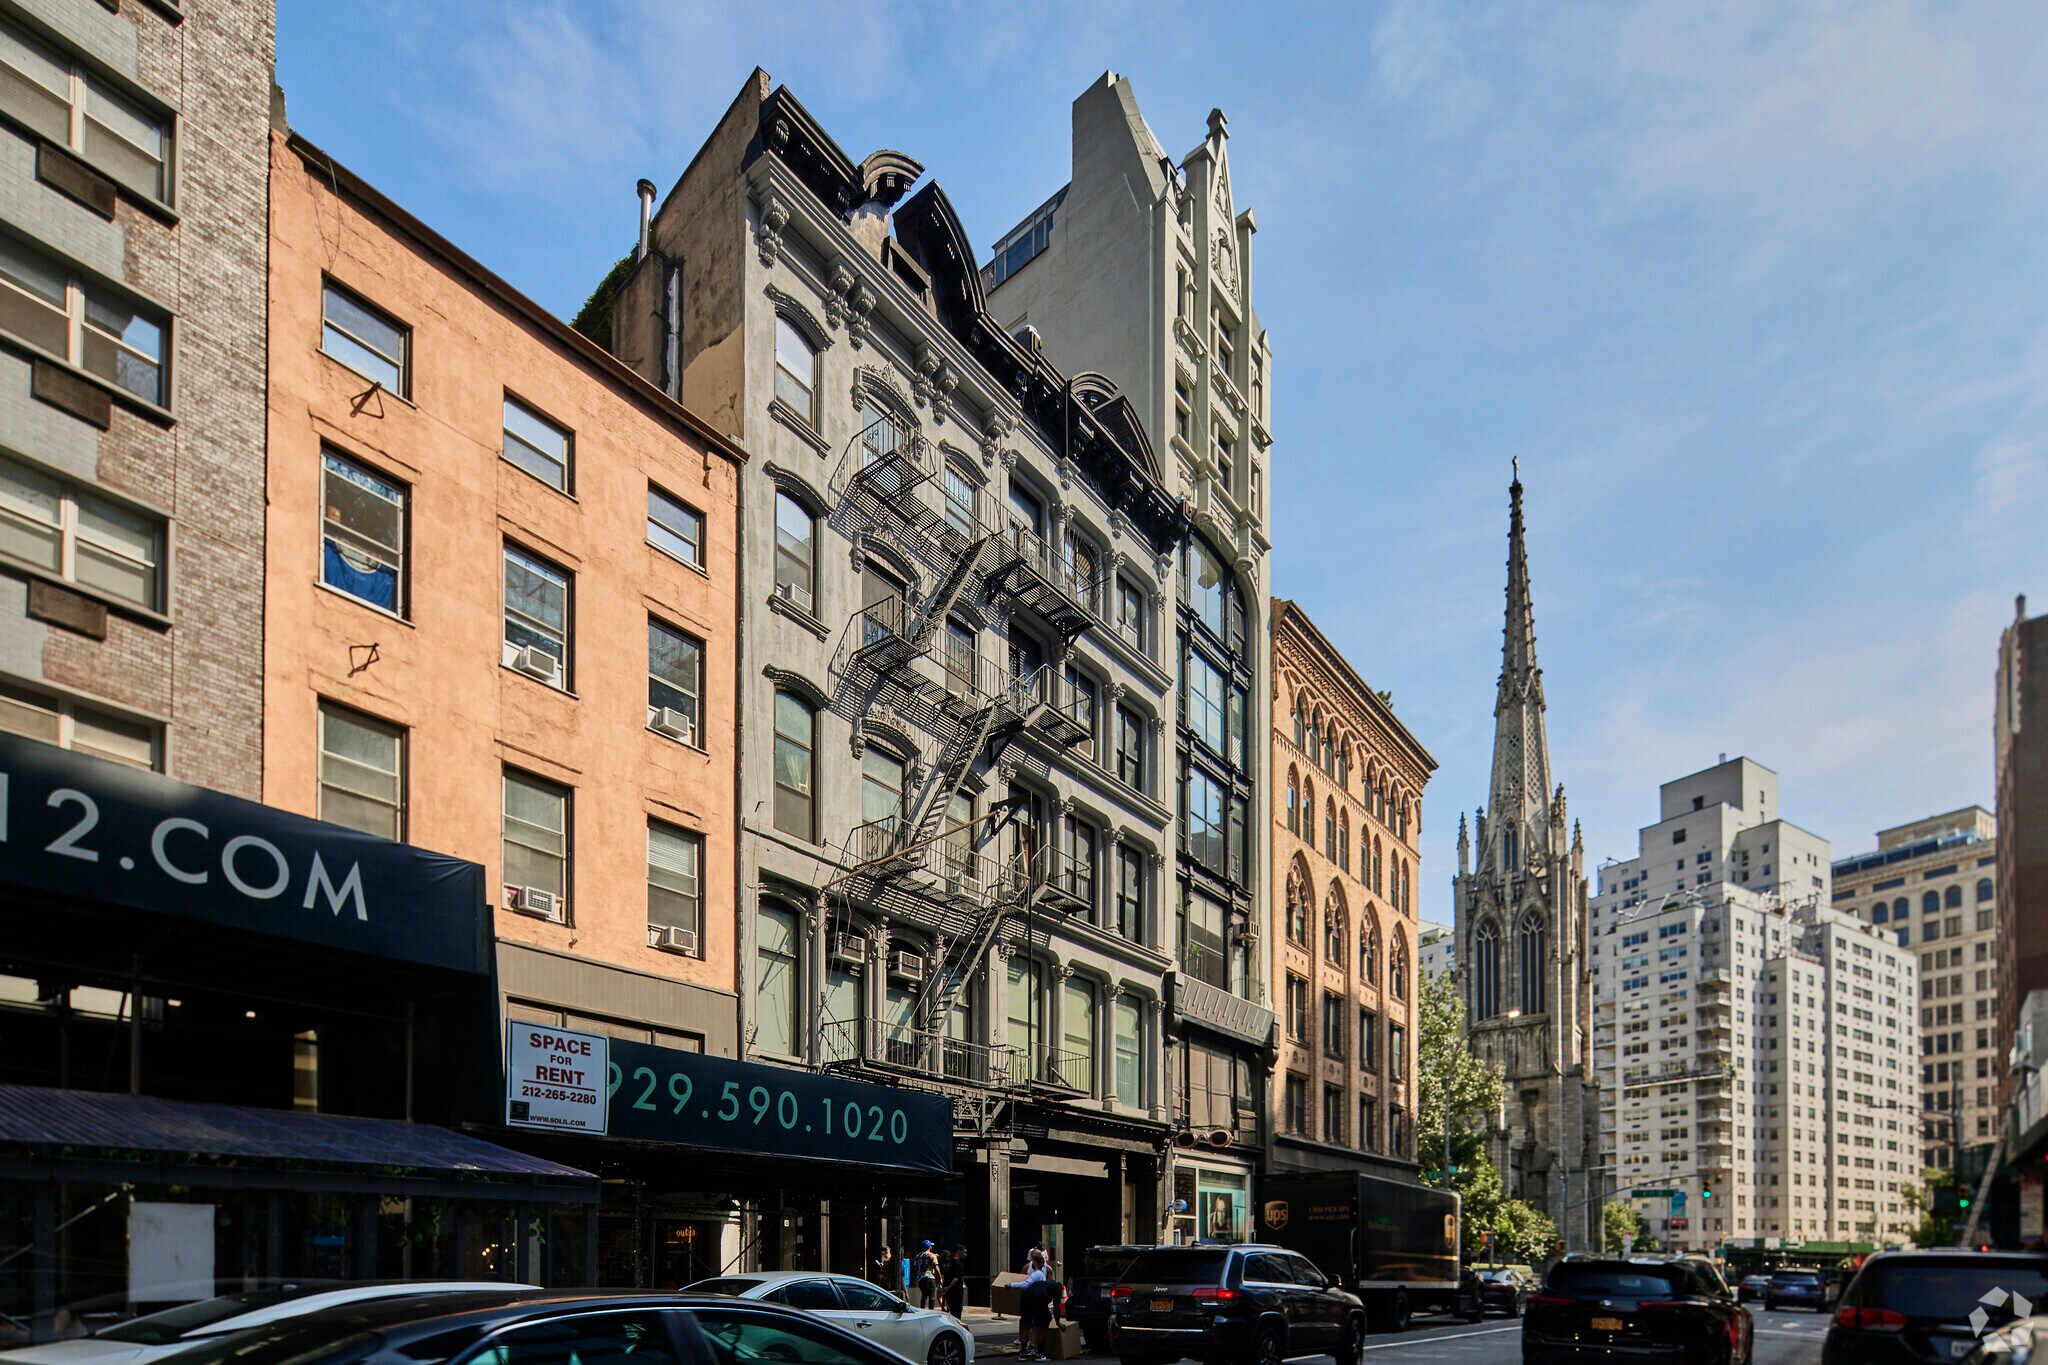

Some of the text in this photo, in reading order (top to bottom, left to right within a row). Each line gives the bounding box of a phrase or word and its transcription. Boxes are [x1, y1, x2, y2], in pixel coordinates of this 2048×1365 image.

[530, 1033, 591, 1056] SPACE
[550, 1054, 572, 1066] FOR
[536, 1065, 585, 1086] RENT
[522, 1086, 596, 1104] 212-265-2280
[608, 1061, 908, 1144] 929.590.1020
[530, 1115, 586, 1127] WWW.SOLIL.COM
